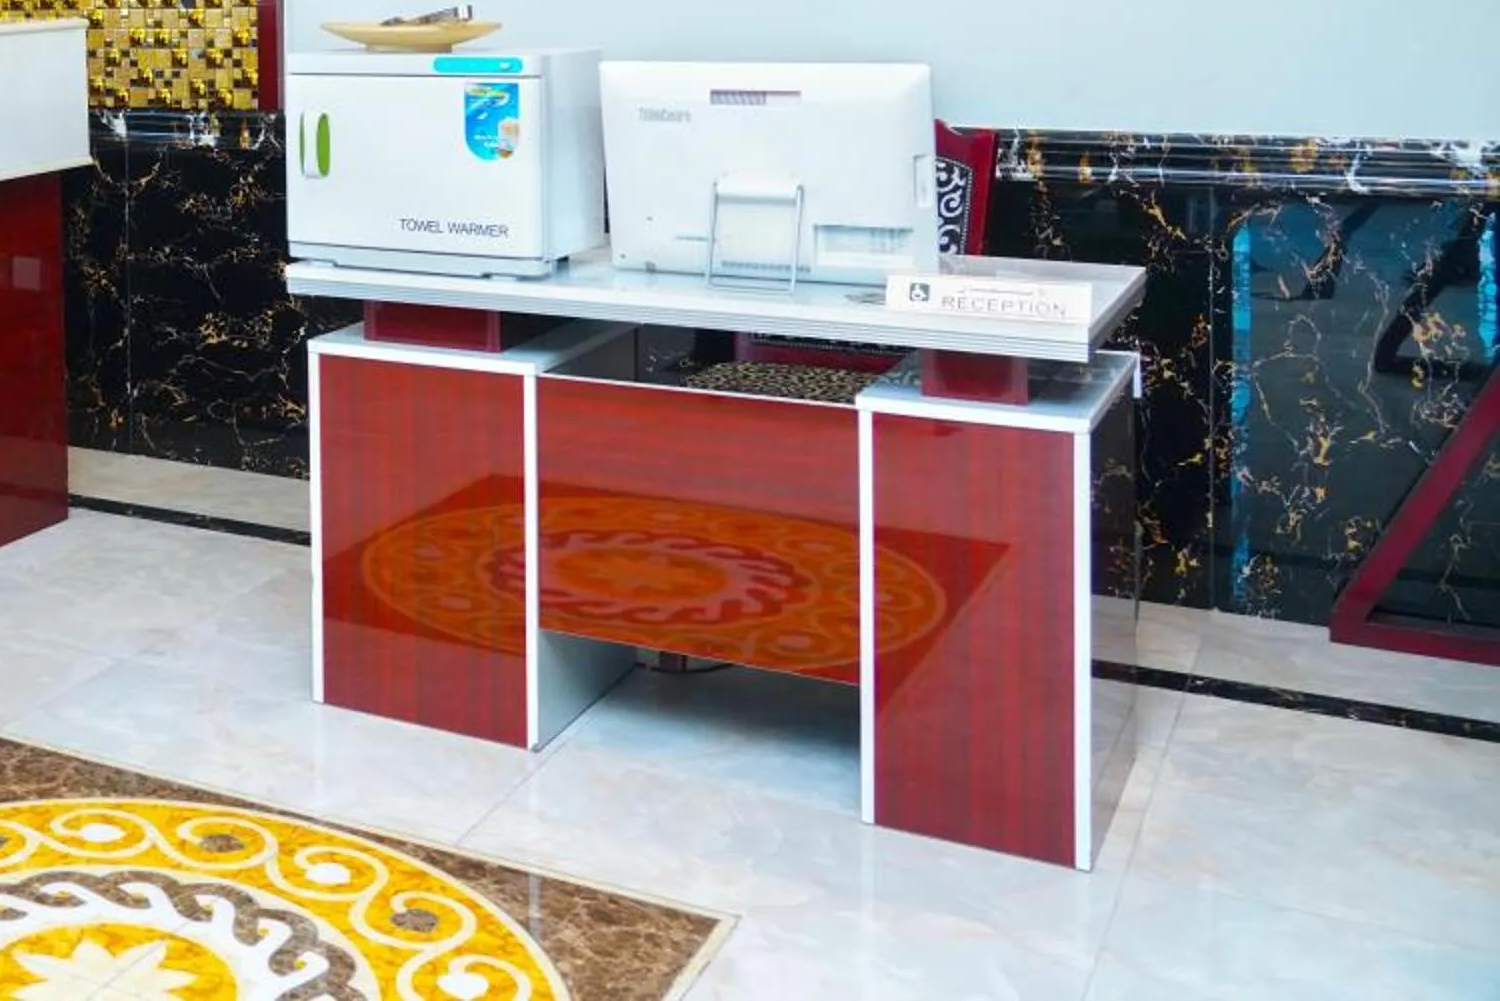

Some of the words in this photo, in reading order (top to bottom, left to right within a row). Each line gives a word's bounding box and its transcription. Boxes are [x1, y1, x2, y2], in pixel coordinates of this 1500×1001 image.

[399, 218, 443, 234] TOWEL
[446, 221, 510, 239] WARMER
[941, 294, 1067, 318] RECEPTION
